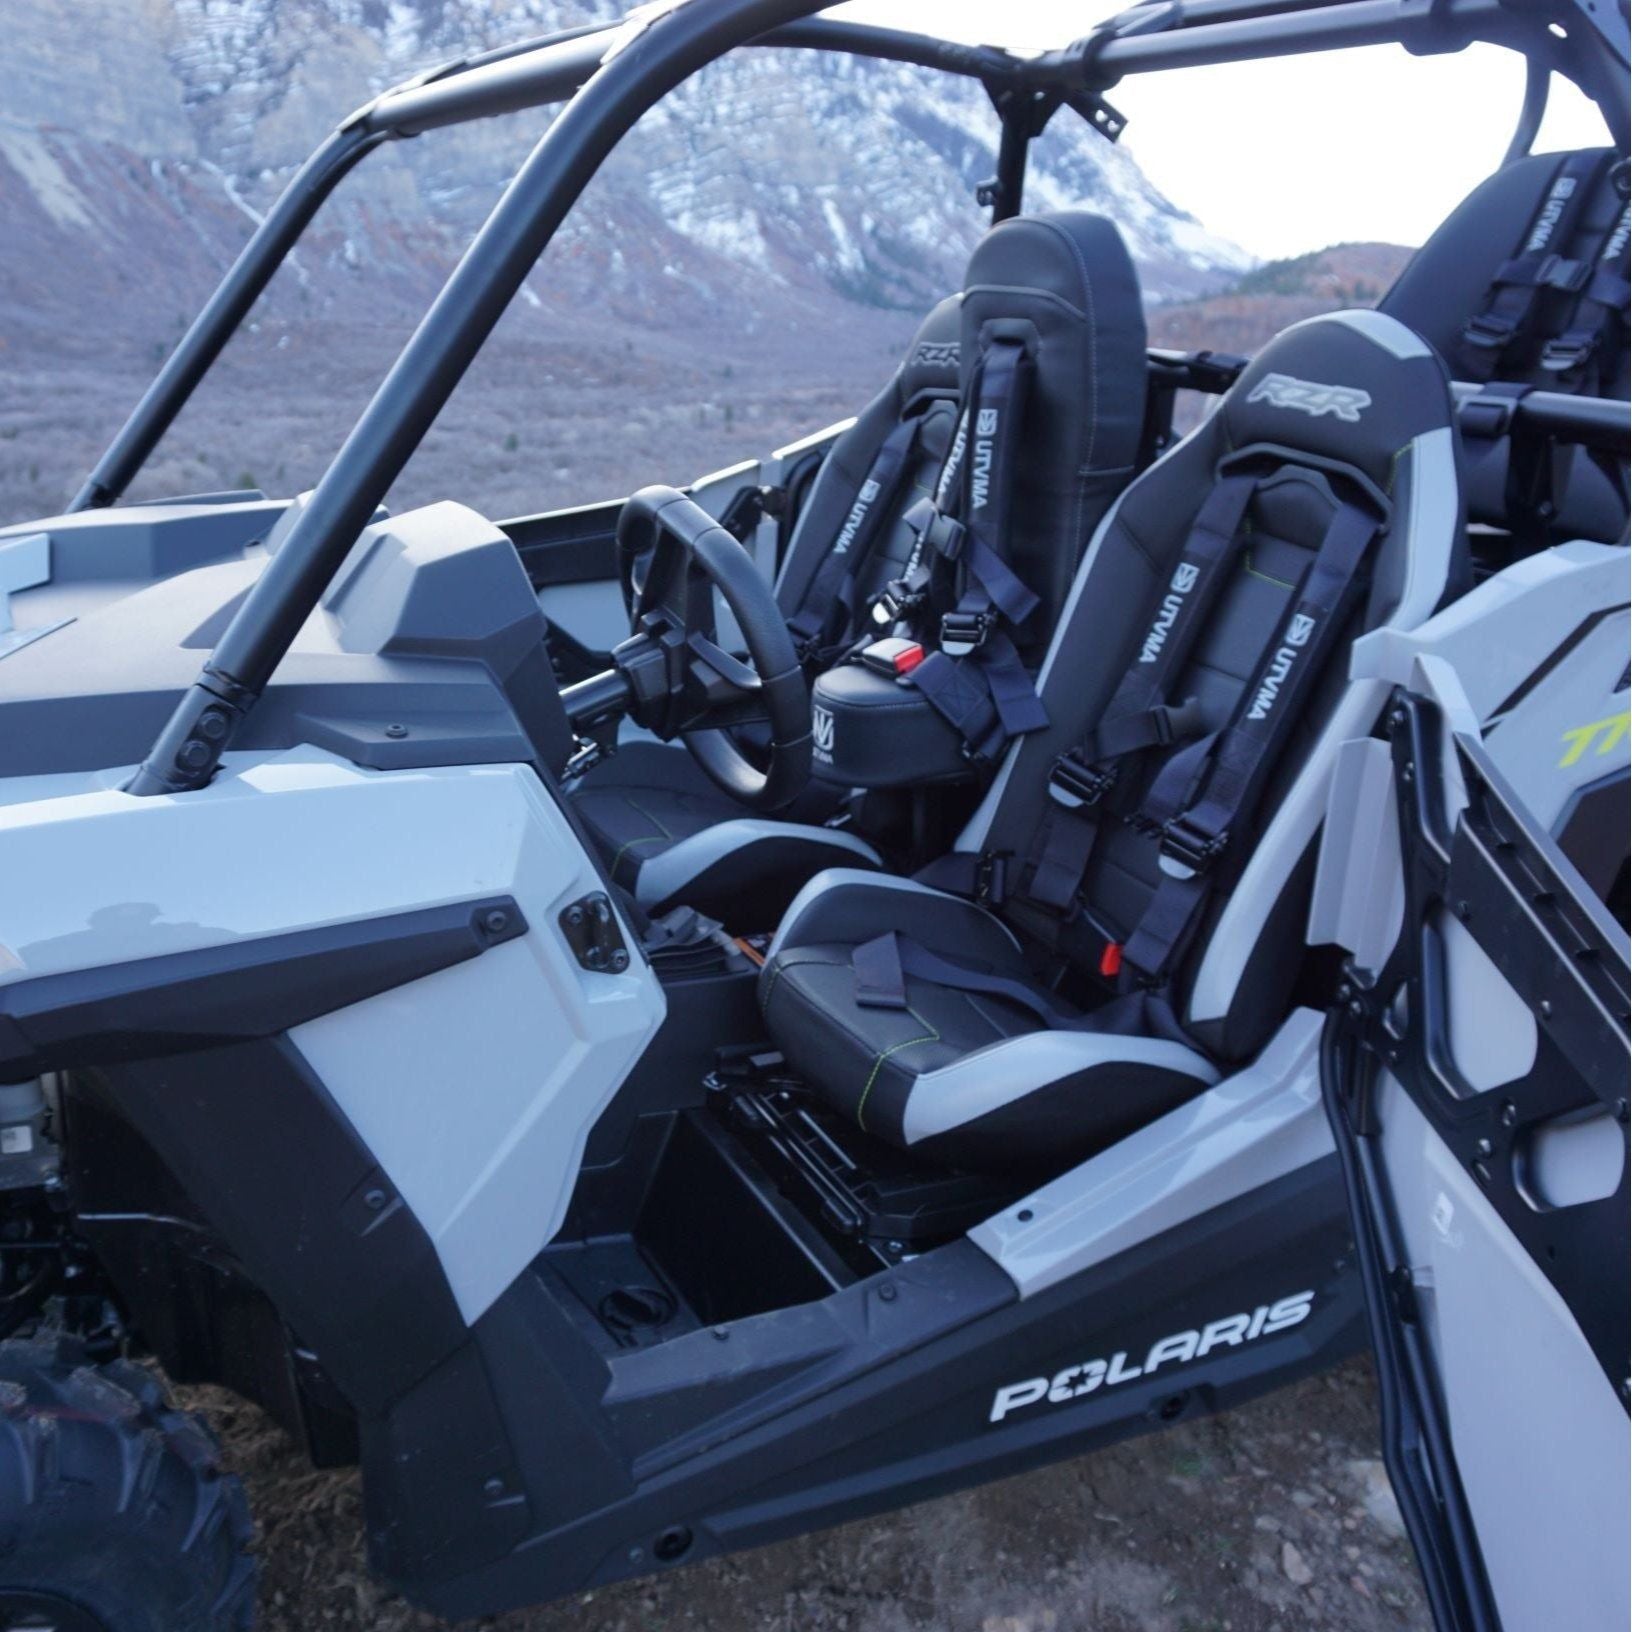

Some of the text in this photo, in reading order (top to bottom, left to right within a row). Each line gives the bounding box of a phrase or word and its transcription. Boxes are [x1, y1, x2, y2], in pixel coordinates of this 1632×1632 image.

[1246, 372, 1372, 422] RZR
[972, 440, 993, 509] UTVMA
[833, 502, 868, 553] UTVMA
[1139, 595, 1183, 663] UTVMA
[1247, 648, 1297, 720] UTVMA
[989, 1289, 1315, 1422] POLARIS
